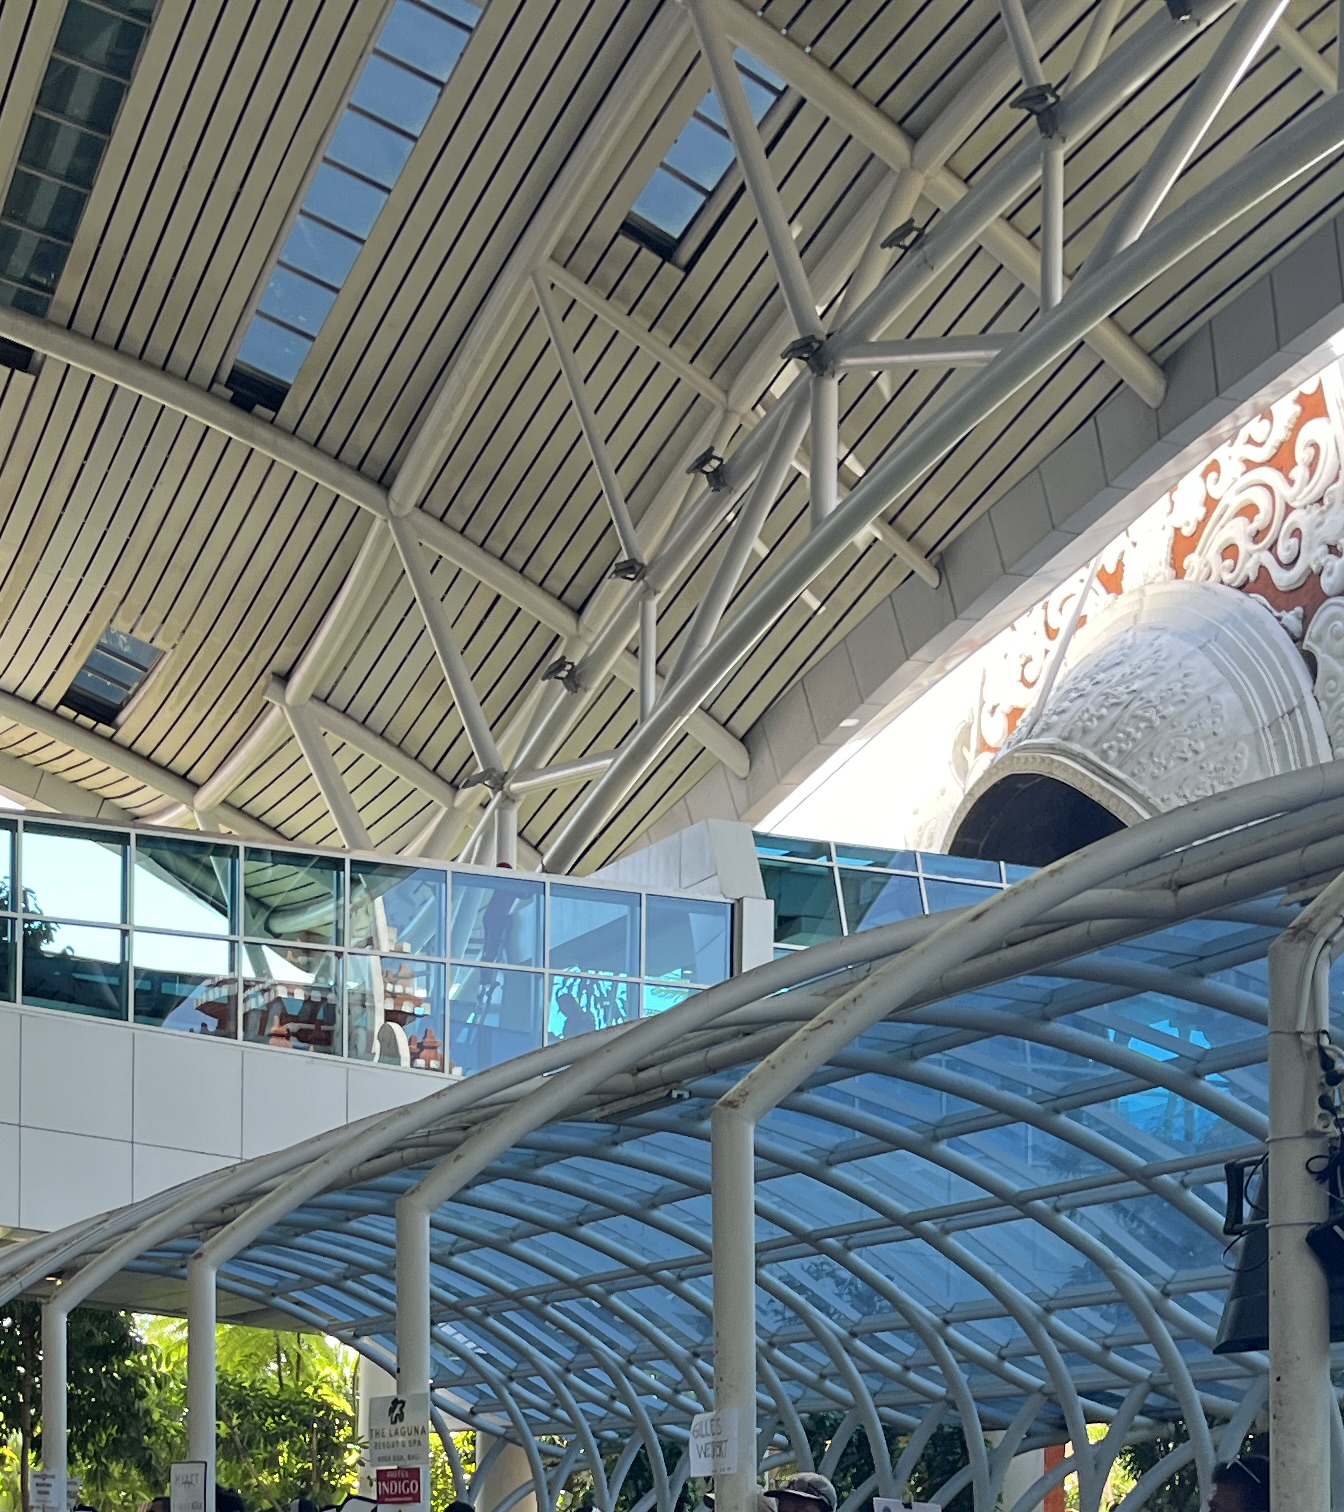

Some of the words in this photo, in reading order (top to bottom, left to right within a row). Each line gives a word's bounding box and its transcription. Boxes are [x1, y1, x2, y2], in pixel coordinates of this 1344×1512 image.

[369, 1428, 386, 1439] THE
[388, 1425, 427, 1438] LAGUNA
[374, 1440, 399, 1450] RESORT
[408, 1439, 422, 1448] SPA
[378, 1479, 419, 1496] INDIGO
